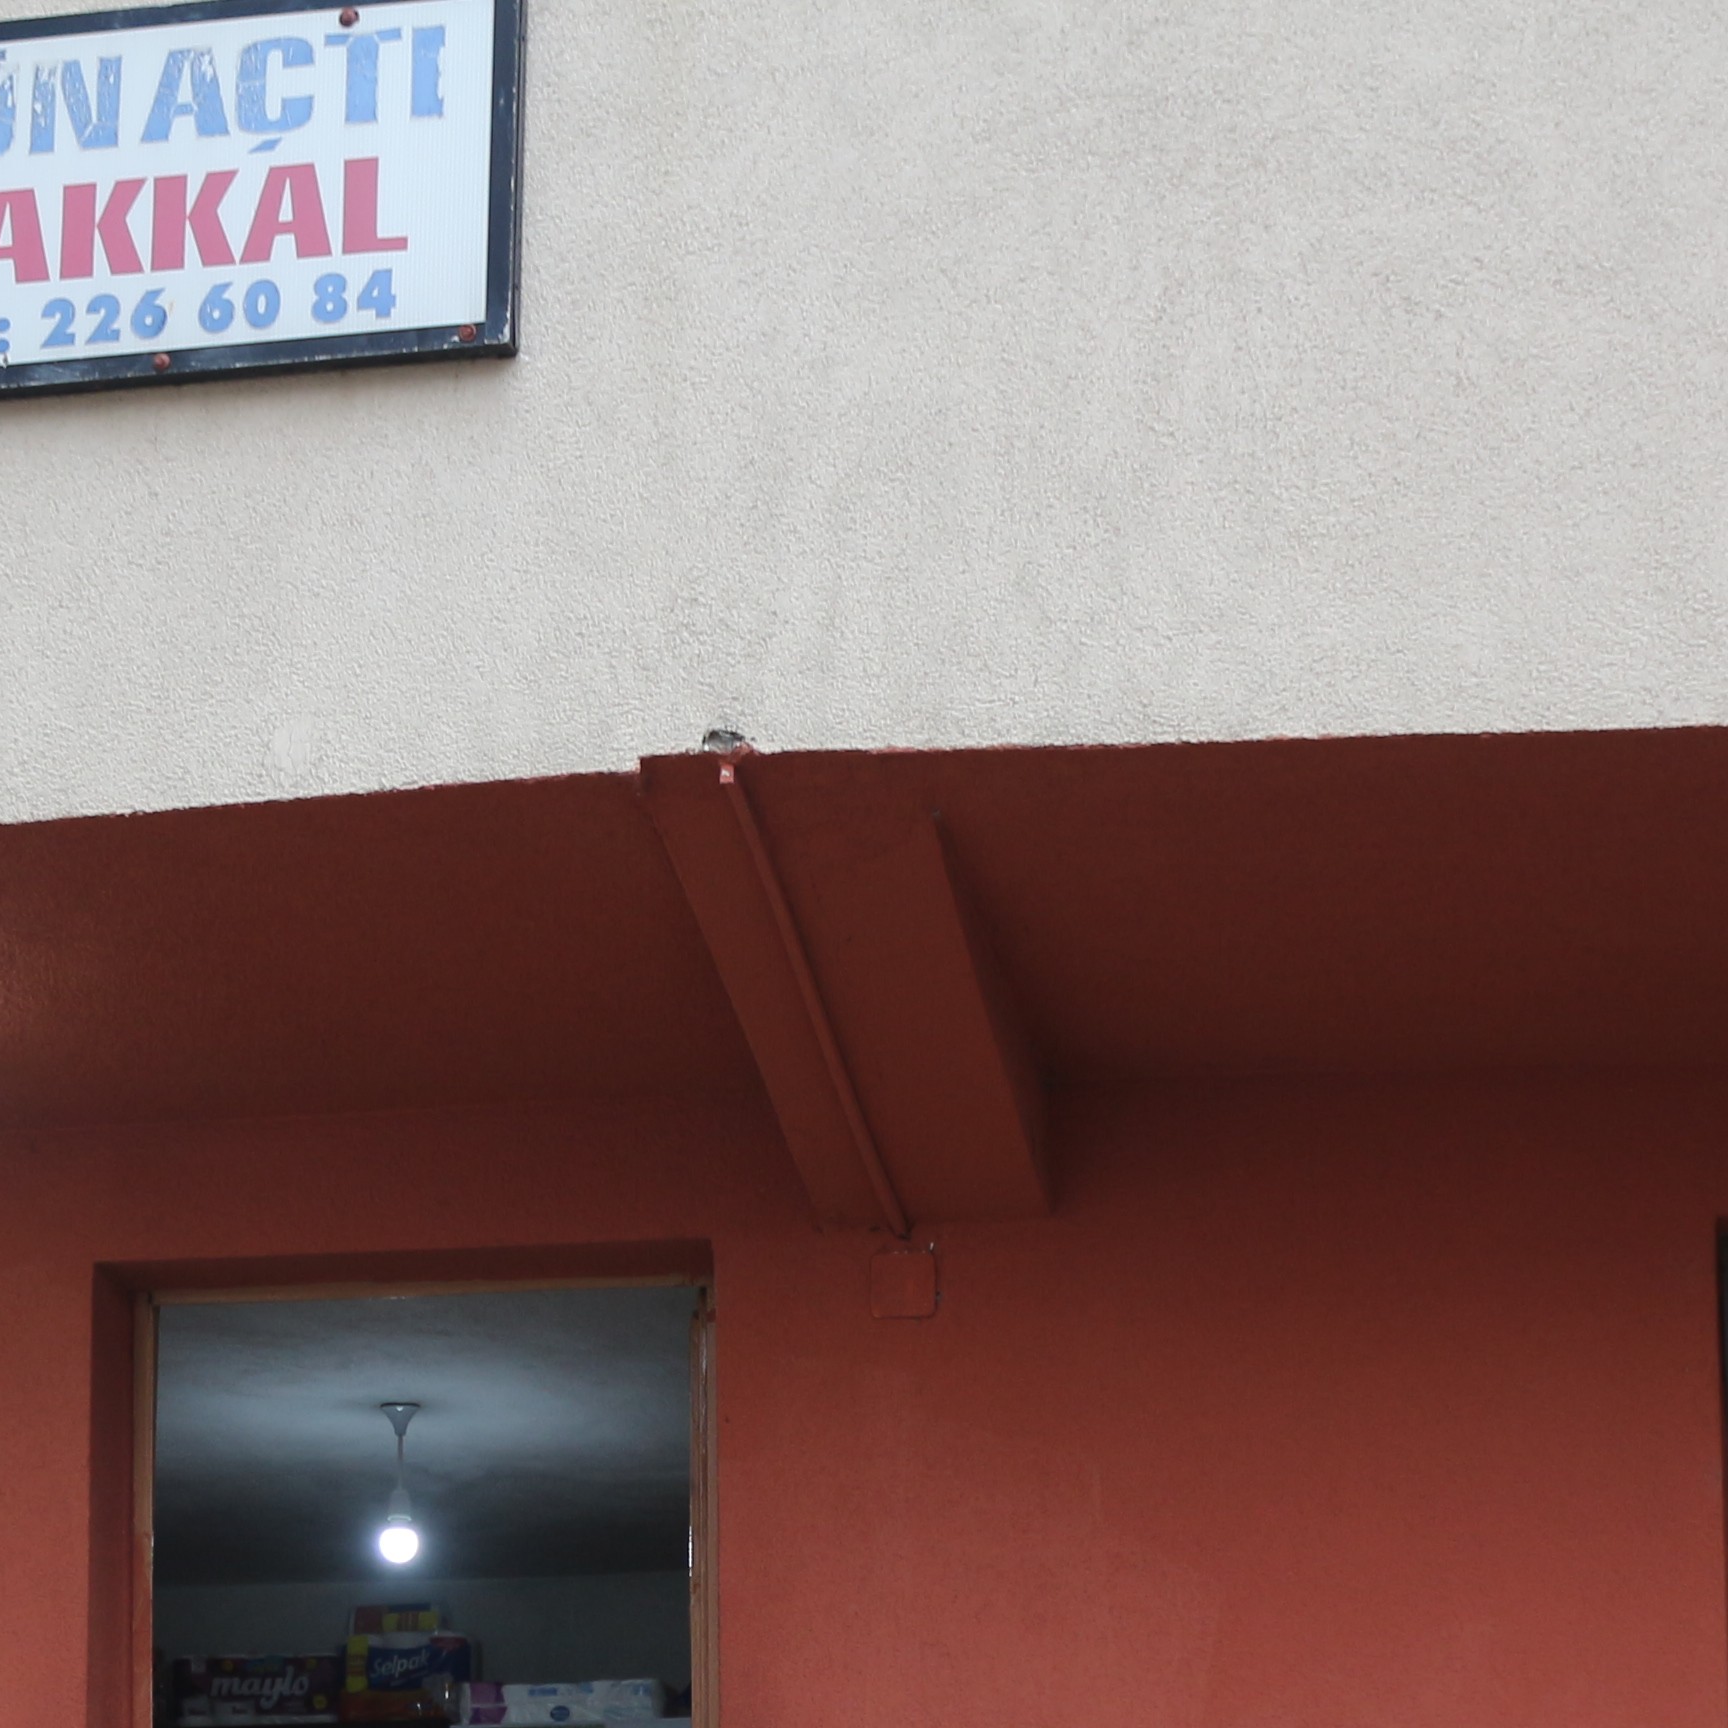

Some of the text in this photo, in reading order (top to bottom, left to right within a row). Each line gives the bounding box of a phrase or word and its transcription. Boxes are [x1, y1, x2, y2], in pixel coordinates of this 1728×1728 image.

[41, 288, 168, 350] 226
[198, 279, 282, 334] 60
[312, 268, 399, 324] 84
[371, 1647, 430, 1680] Selpak
[209, 1665, 310, 1710] maylo
